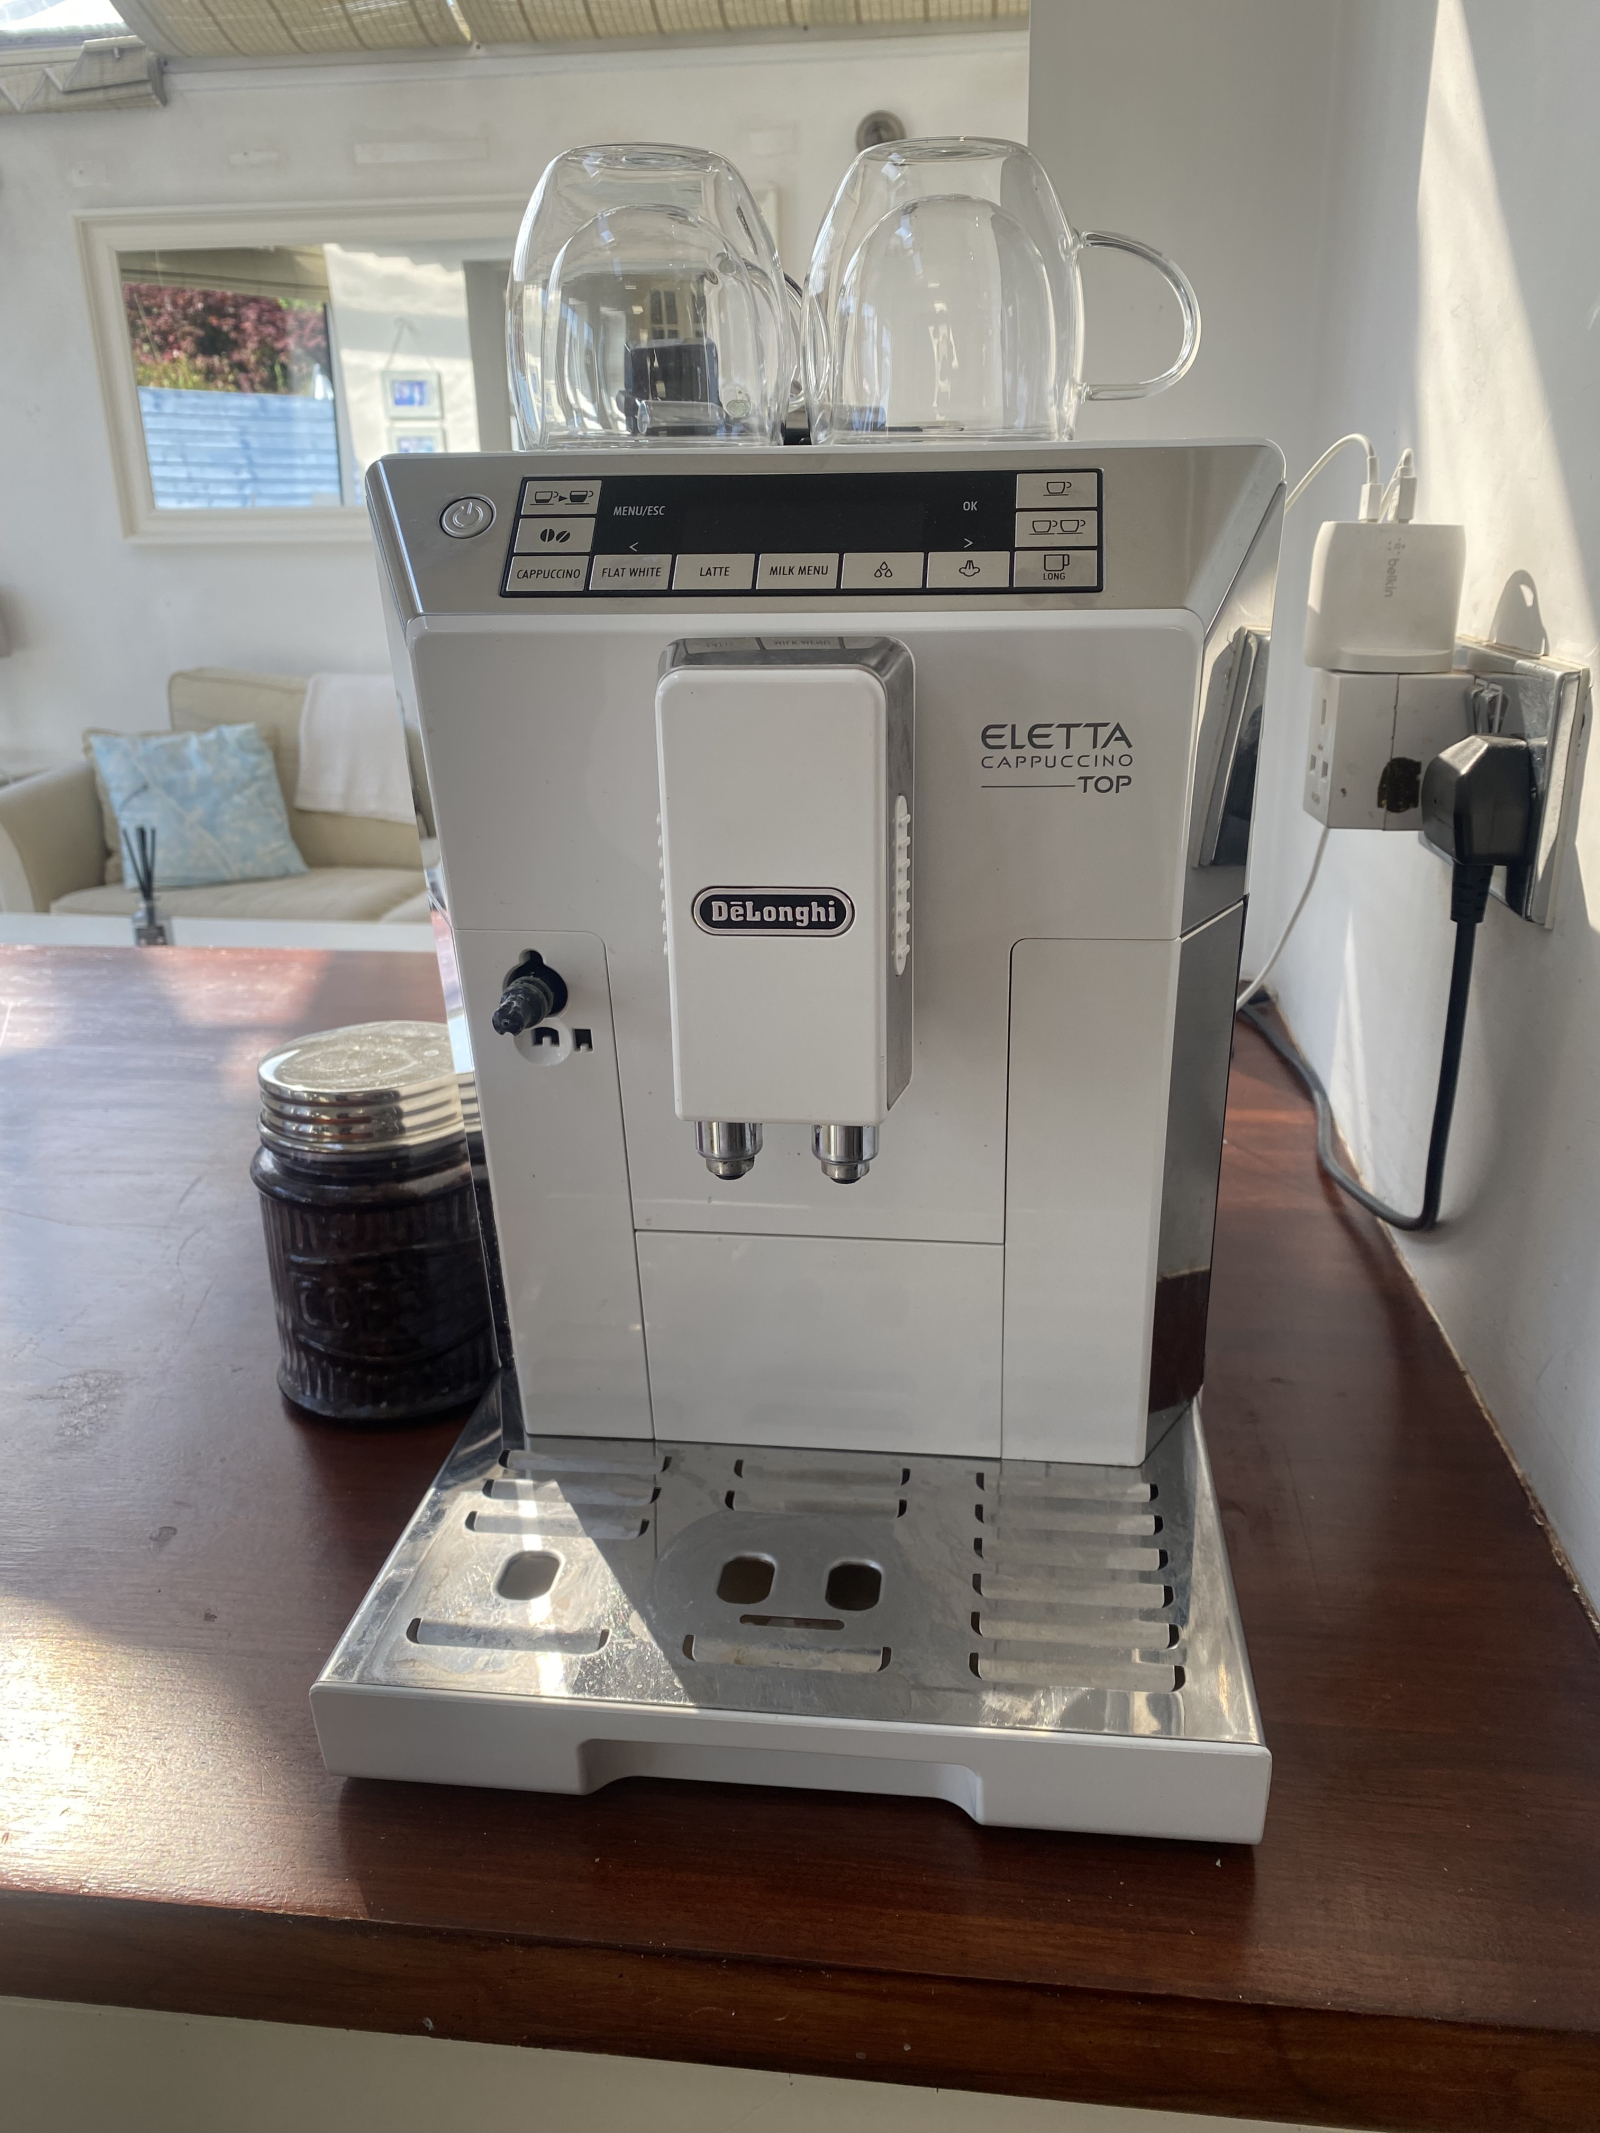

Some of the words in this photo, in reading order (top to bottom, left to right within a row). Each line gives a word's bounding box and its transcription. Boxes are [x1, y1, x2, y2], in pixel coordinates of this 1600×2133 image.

[613, 505, 666, 516] MENU/ESC
[963, 501, 978, 511] OK
[516, 568, 581, 579] CAPPUCCINO
[601, 567, 627, 578] FLAT
[629, 567, 662, 577] WHITE
[699, 566, 731, 577] LATTE
[769, 566, 796, 576] MILK
[797, 565, 829, 576] MENU
[1043, 572, 1066, 581] LONG
[1384, 558, 1399, 598] belkin
[981, 722, 1133, 750] ELETTA
[981, 754, 1133, 769] CAPPUCCINO
[1077, 775, 1132, 794] TOP
